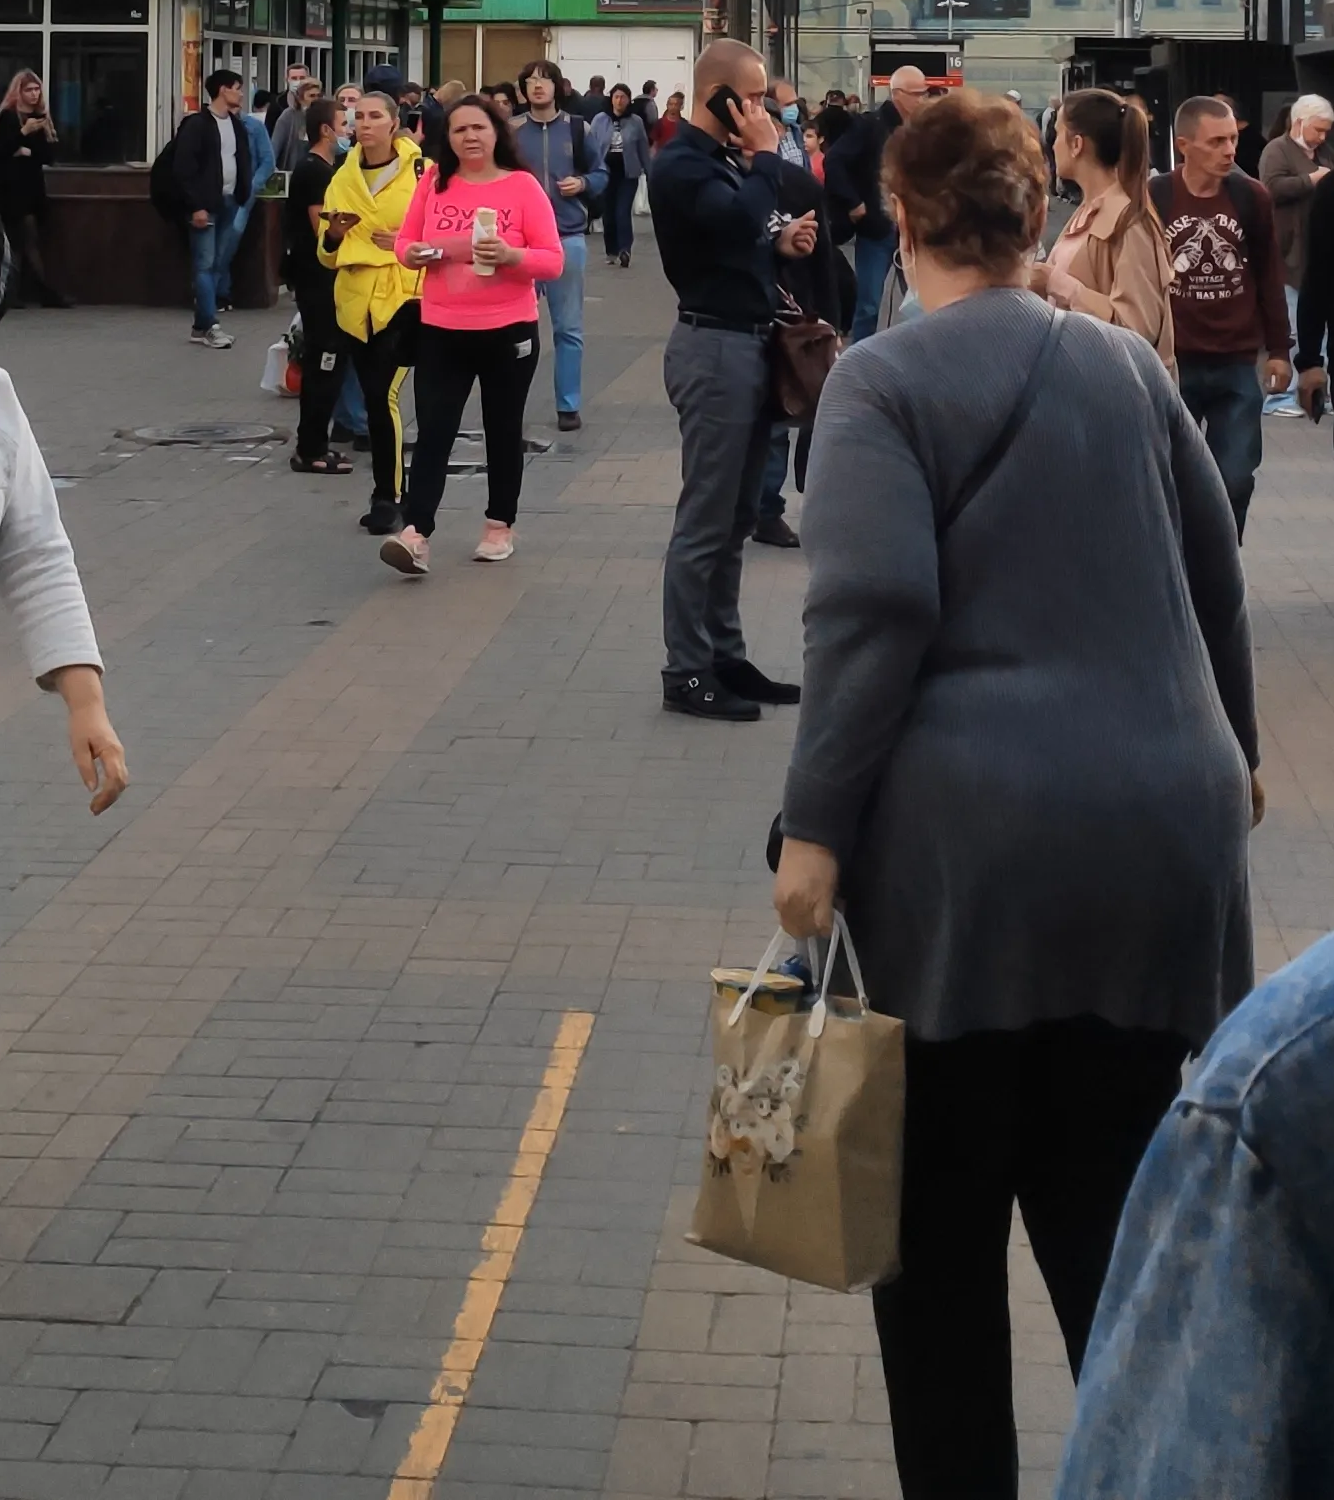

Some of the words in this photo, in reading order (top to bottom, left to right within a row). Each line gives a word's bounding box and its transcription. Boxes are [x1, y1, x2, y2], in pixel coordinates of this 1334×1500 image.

[949, 56, 962, 68] 16
[433, 201, 512, 221] LOVY
[1195, 290, 1216, 300] HAS
